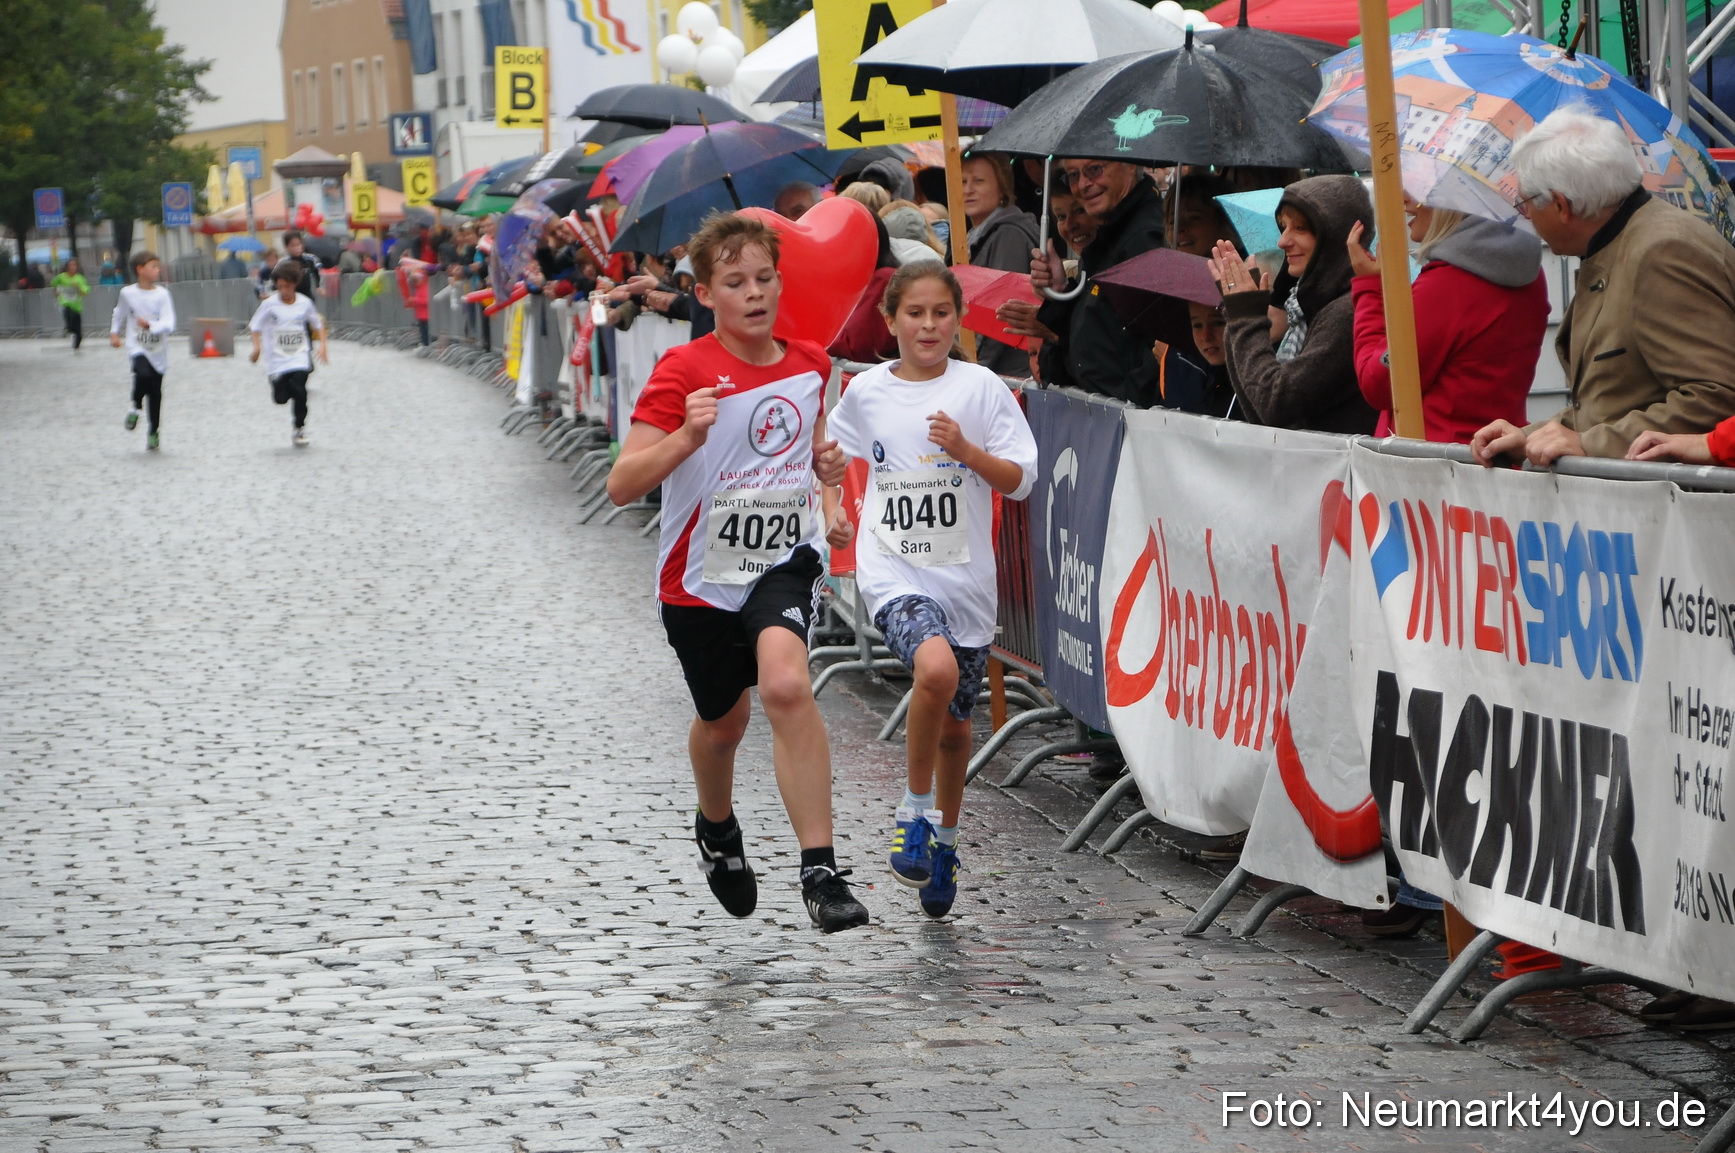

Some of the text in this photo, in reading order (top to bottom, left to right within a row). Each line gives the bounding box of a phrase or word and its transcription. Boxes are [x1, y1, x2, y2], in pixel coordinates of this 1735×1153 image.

[502, 50, 545, 65] Block
[510, 72, 536, 110] B
[411, 171, 428, 195] C
[358, 194, 371, 212] D
[785, 462, 806, 472] HERZ
[877, 479, 947, 493] PARTL Neumarkt
[714, 498, 796, 509] PARTL Neumarkt
[880, 492, 958, 532] 4040
[717, 512, 801, 551] 4029
[900, 540, 932, 554] Sara
[1403, 497, 1644, 684] INTERSPORT
[1708, 871, 1735, 925] N
